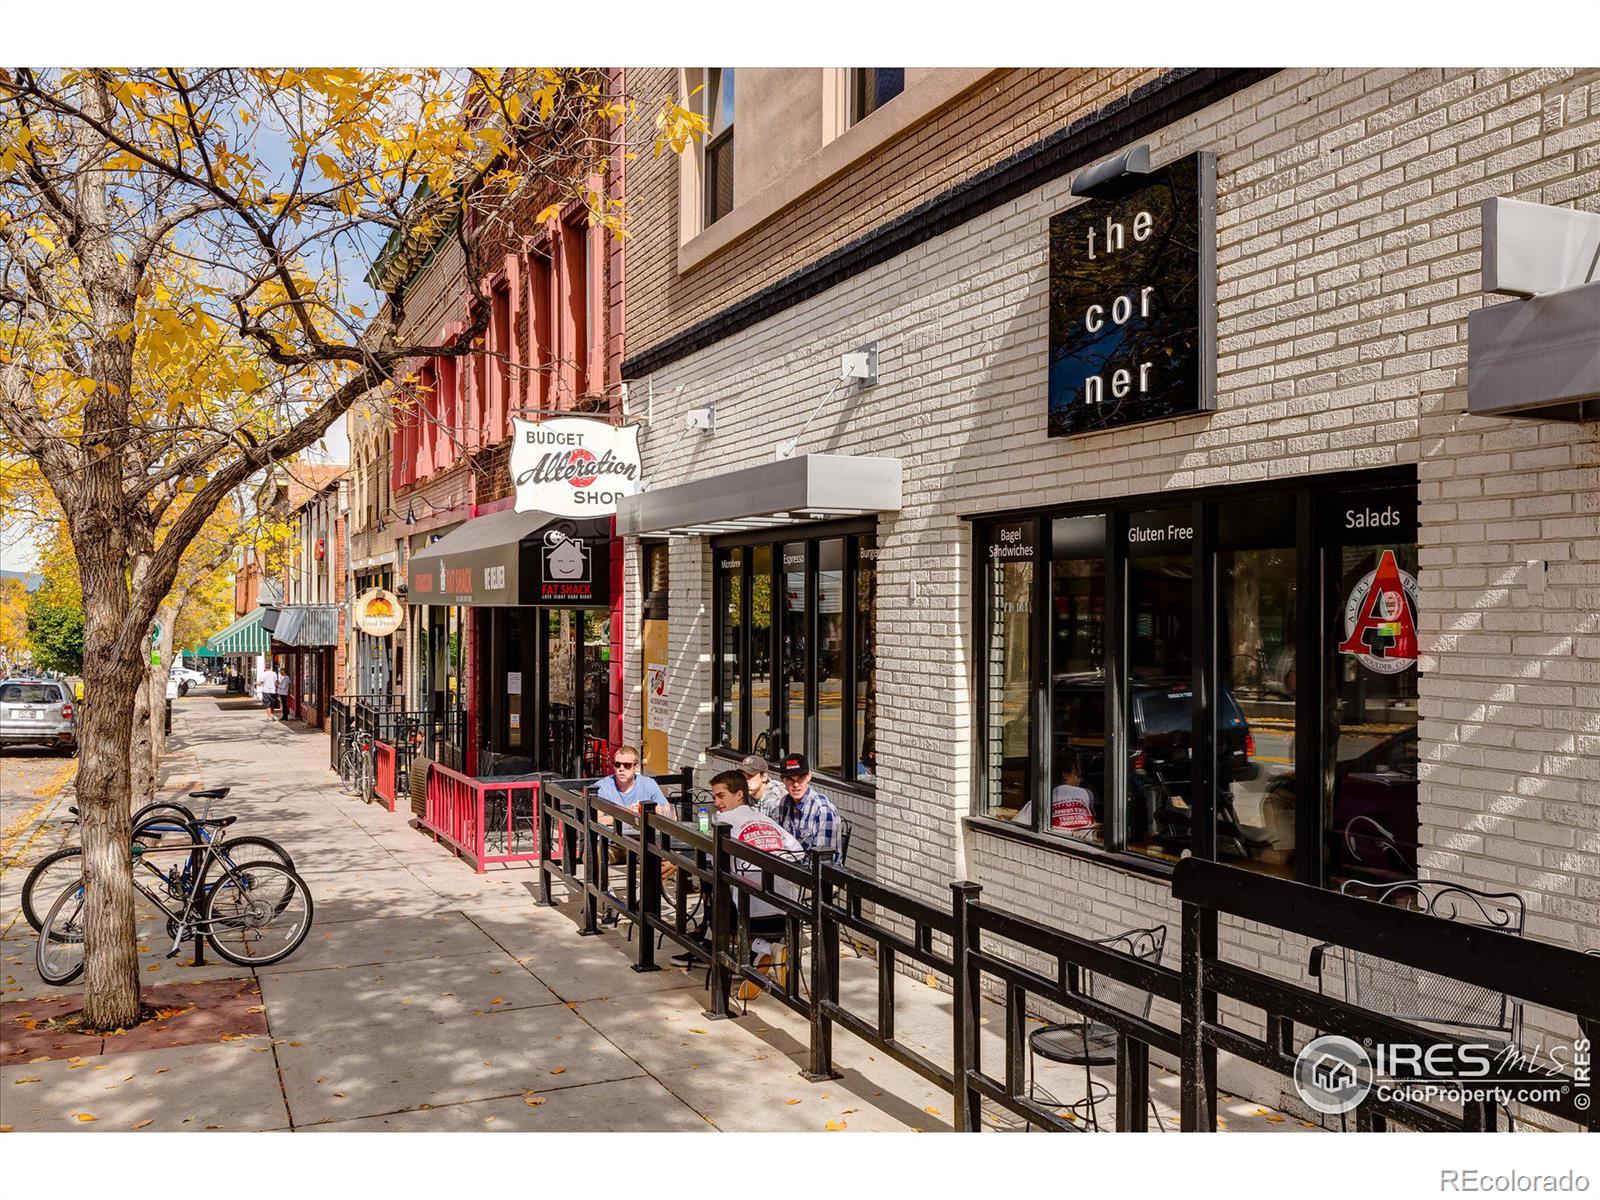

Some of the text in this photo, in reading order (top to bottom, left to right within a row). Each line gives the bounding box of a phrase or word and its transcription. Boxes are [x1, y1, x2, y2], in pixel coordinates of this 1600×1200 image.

[1086, 211, 1153, 260] the
[1085, 286, 1154, 333] cor
[1085, 361, 1153, 404] ner
[526, 431, 584, 446] BUDGET
[516, 449, 637, 486] Alteration
[1345, 506, 1400, 528] Salads
[1000, 528, 1022, 542] Bagel
[1128, 525, 1194, 542] Gluten Free
[783, 554, 804, 564] Espresso
[989, 545, 1034, 557] Sandwiches
[721, 559, 741, 569] Microbrew
[542, 584, 592, 595] FAT SHACK
[1348, 579, 1369, 623] AVERY
